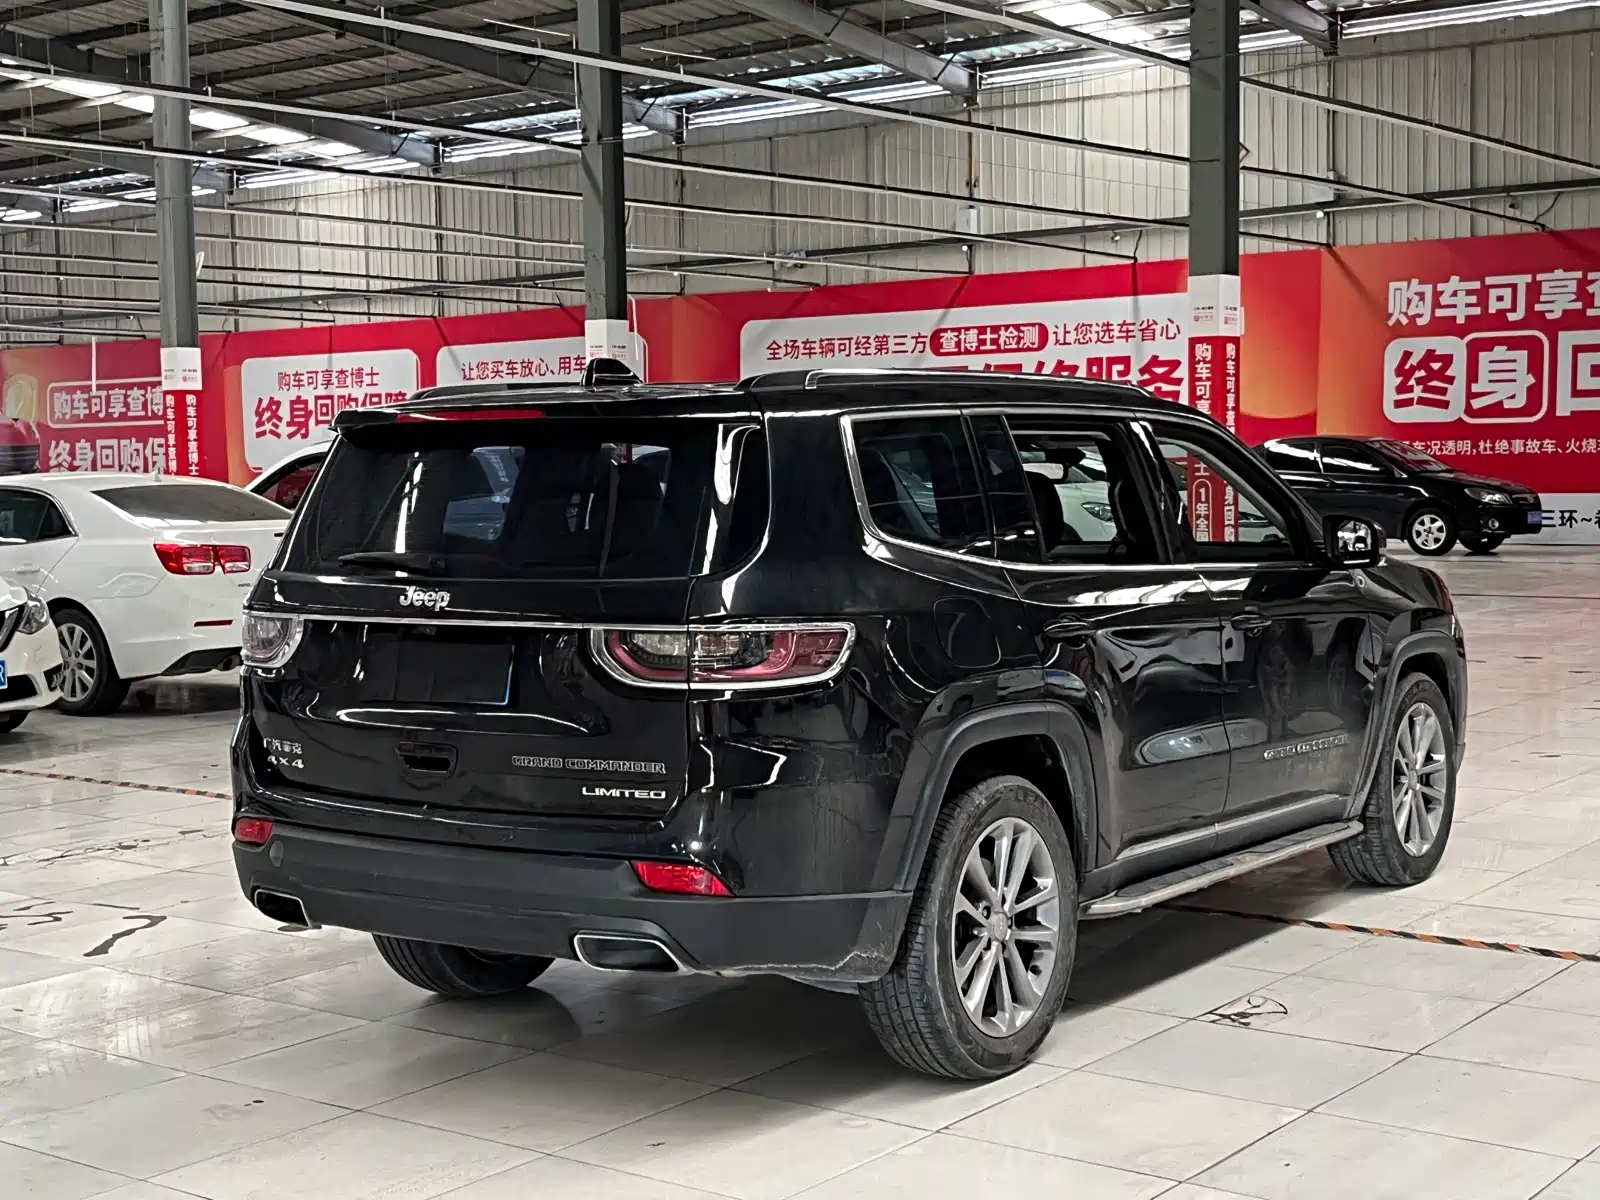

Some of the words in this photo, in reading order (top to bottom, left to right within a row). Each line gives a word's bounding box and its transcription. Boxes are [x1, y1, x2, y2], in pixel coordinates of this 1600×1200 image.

[766, 332, 928, 361] 全场车辆可经第三方
[939, 325, 1039, 353] 查博士检测
[1052, 317, 1181, 347] 让您选车省心
[277, 366, 380, 391] 购车可享查博士
[165, 394, 177, 476] 购车可享查博
[400, 586, 450, 611] Jeep
[512, 756, 563, 769] GRAND
[565, 759, 666, 774] COMMANDER
[582, 787, 666, 799] LIMITED
